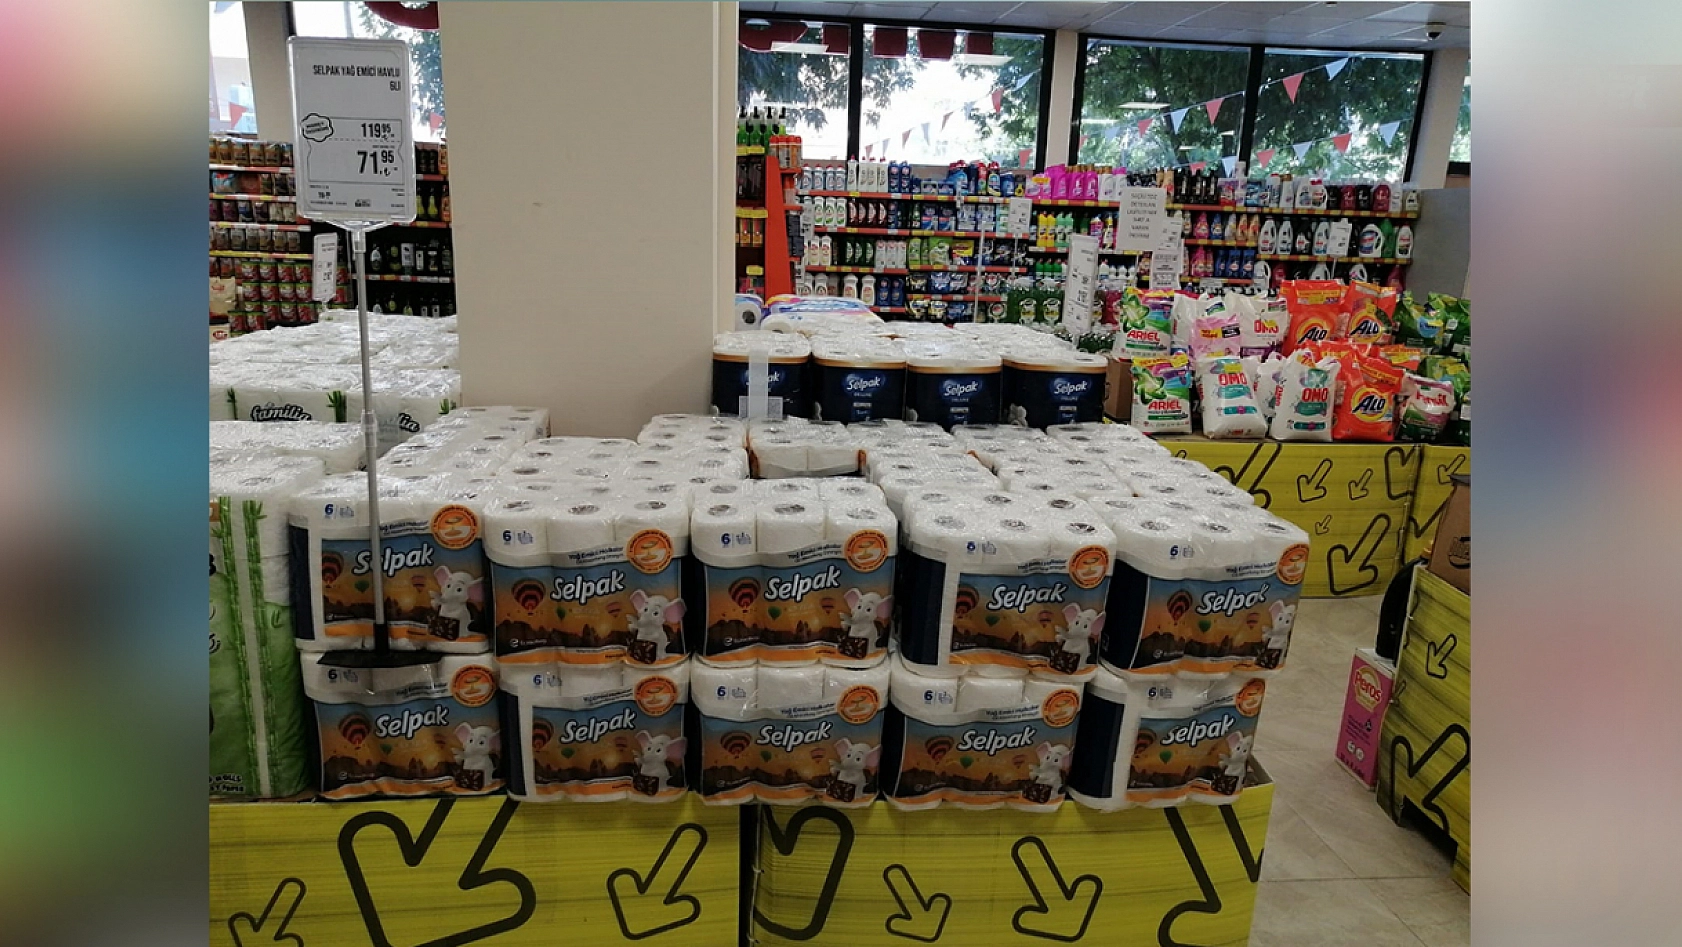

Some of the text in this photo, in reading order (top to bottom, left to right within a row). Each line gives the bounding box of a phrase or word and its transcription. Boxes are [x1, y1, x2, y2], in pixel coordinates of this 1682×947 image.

[313, 64, 340, 76] SELPAK
[361, 122, 381, 138] 119
[1127, 330, 1160, 341] ARIEL
[1350, 320, 1381, 336] ALO
[846, 376, 881, 391] Selpak
[1217, 373, 1248, 386] OMO
[944, 380, 979, 396] Selpak
[1054, 380, 1088, 395] Selpak
[1302, 388, 1328, 402] OMO
[1148, 400, 1182, 410] ARIEL
[1352, 395, 1386, 414] ALO
[324, 503, 334, 516] 6
[502, 529, 512, 542] 6
[721, 533, 731, 545] 6
[1170, 545, 1179, 557] 6
[353, 542, 434, 577] Slpak
[550, 569, 625, 605] Selpak
[764, 565, 841, 602] Selpak
[986, 582, 1068, 613] Selpak
[328, 669, 338, 680] 6
[532, 674, 542, 686] 6
[717, 686, 727, 697] 6
[1354, 669, 1381, 702] Peros
[923, 690, 933, 701] 6
[375, 704, 450, 739] Selpak
[560, 707, 637, 744] Selpak
[756, 721, 834, 752] Selpak
[1160, 714, 1235, 747] Selpak
[957, 725, 1037, 756] Selpak
